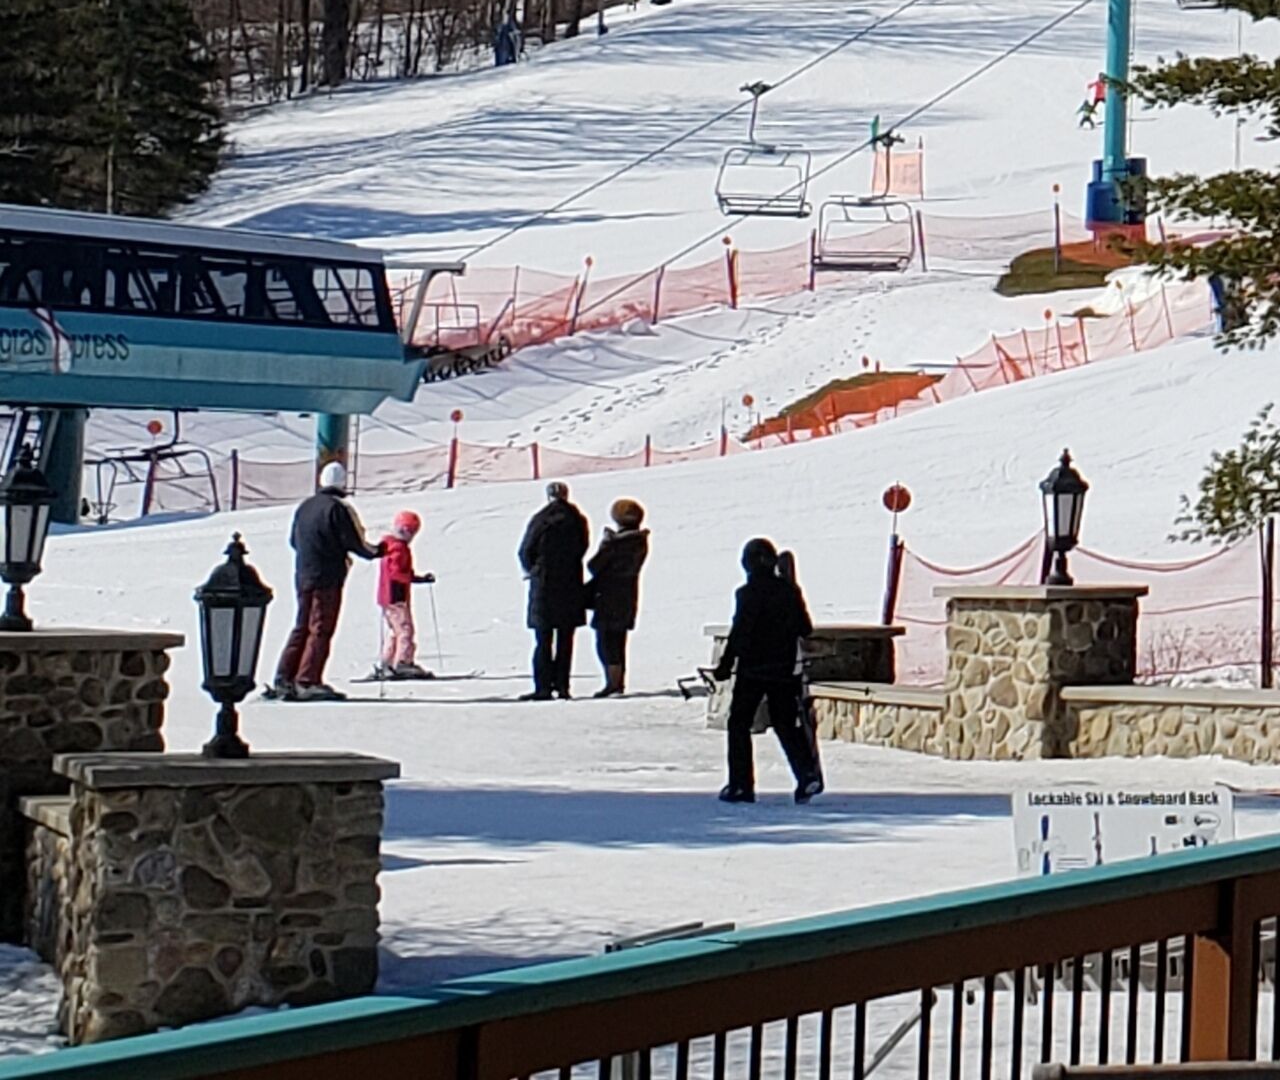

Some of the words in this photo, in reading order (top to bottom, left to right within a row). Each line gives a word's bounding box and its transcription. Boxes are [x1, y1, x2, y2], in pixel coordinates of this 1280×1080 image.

[66, 332, 130, 369] press
[1028, 791, 1082, 807] Lockable
[1085, 791, 1104, 806] Ski
[1118, 790, 1186, 806] Snowboard
[1189, 790, 1218, 806] Rack
